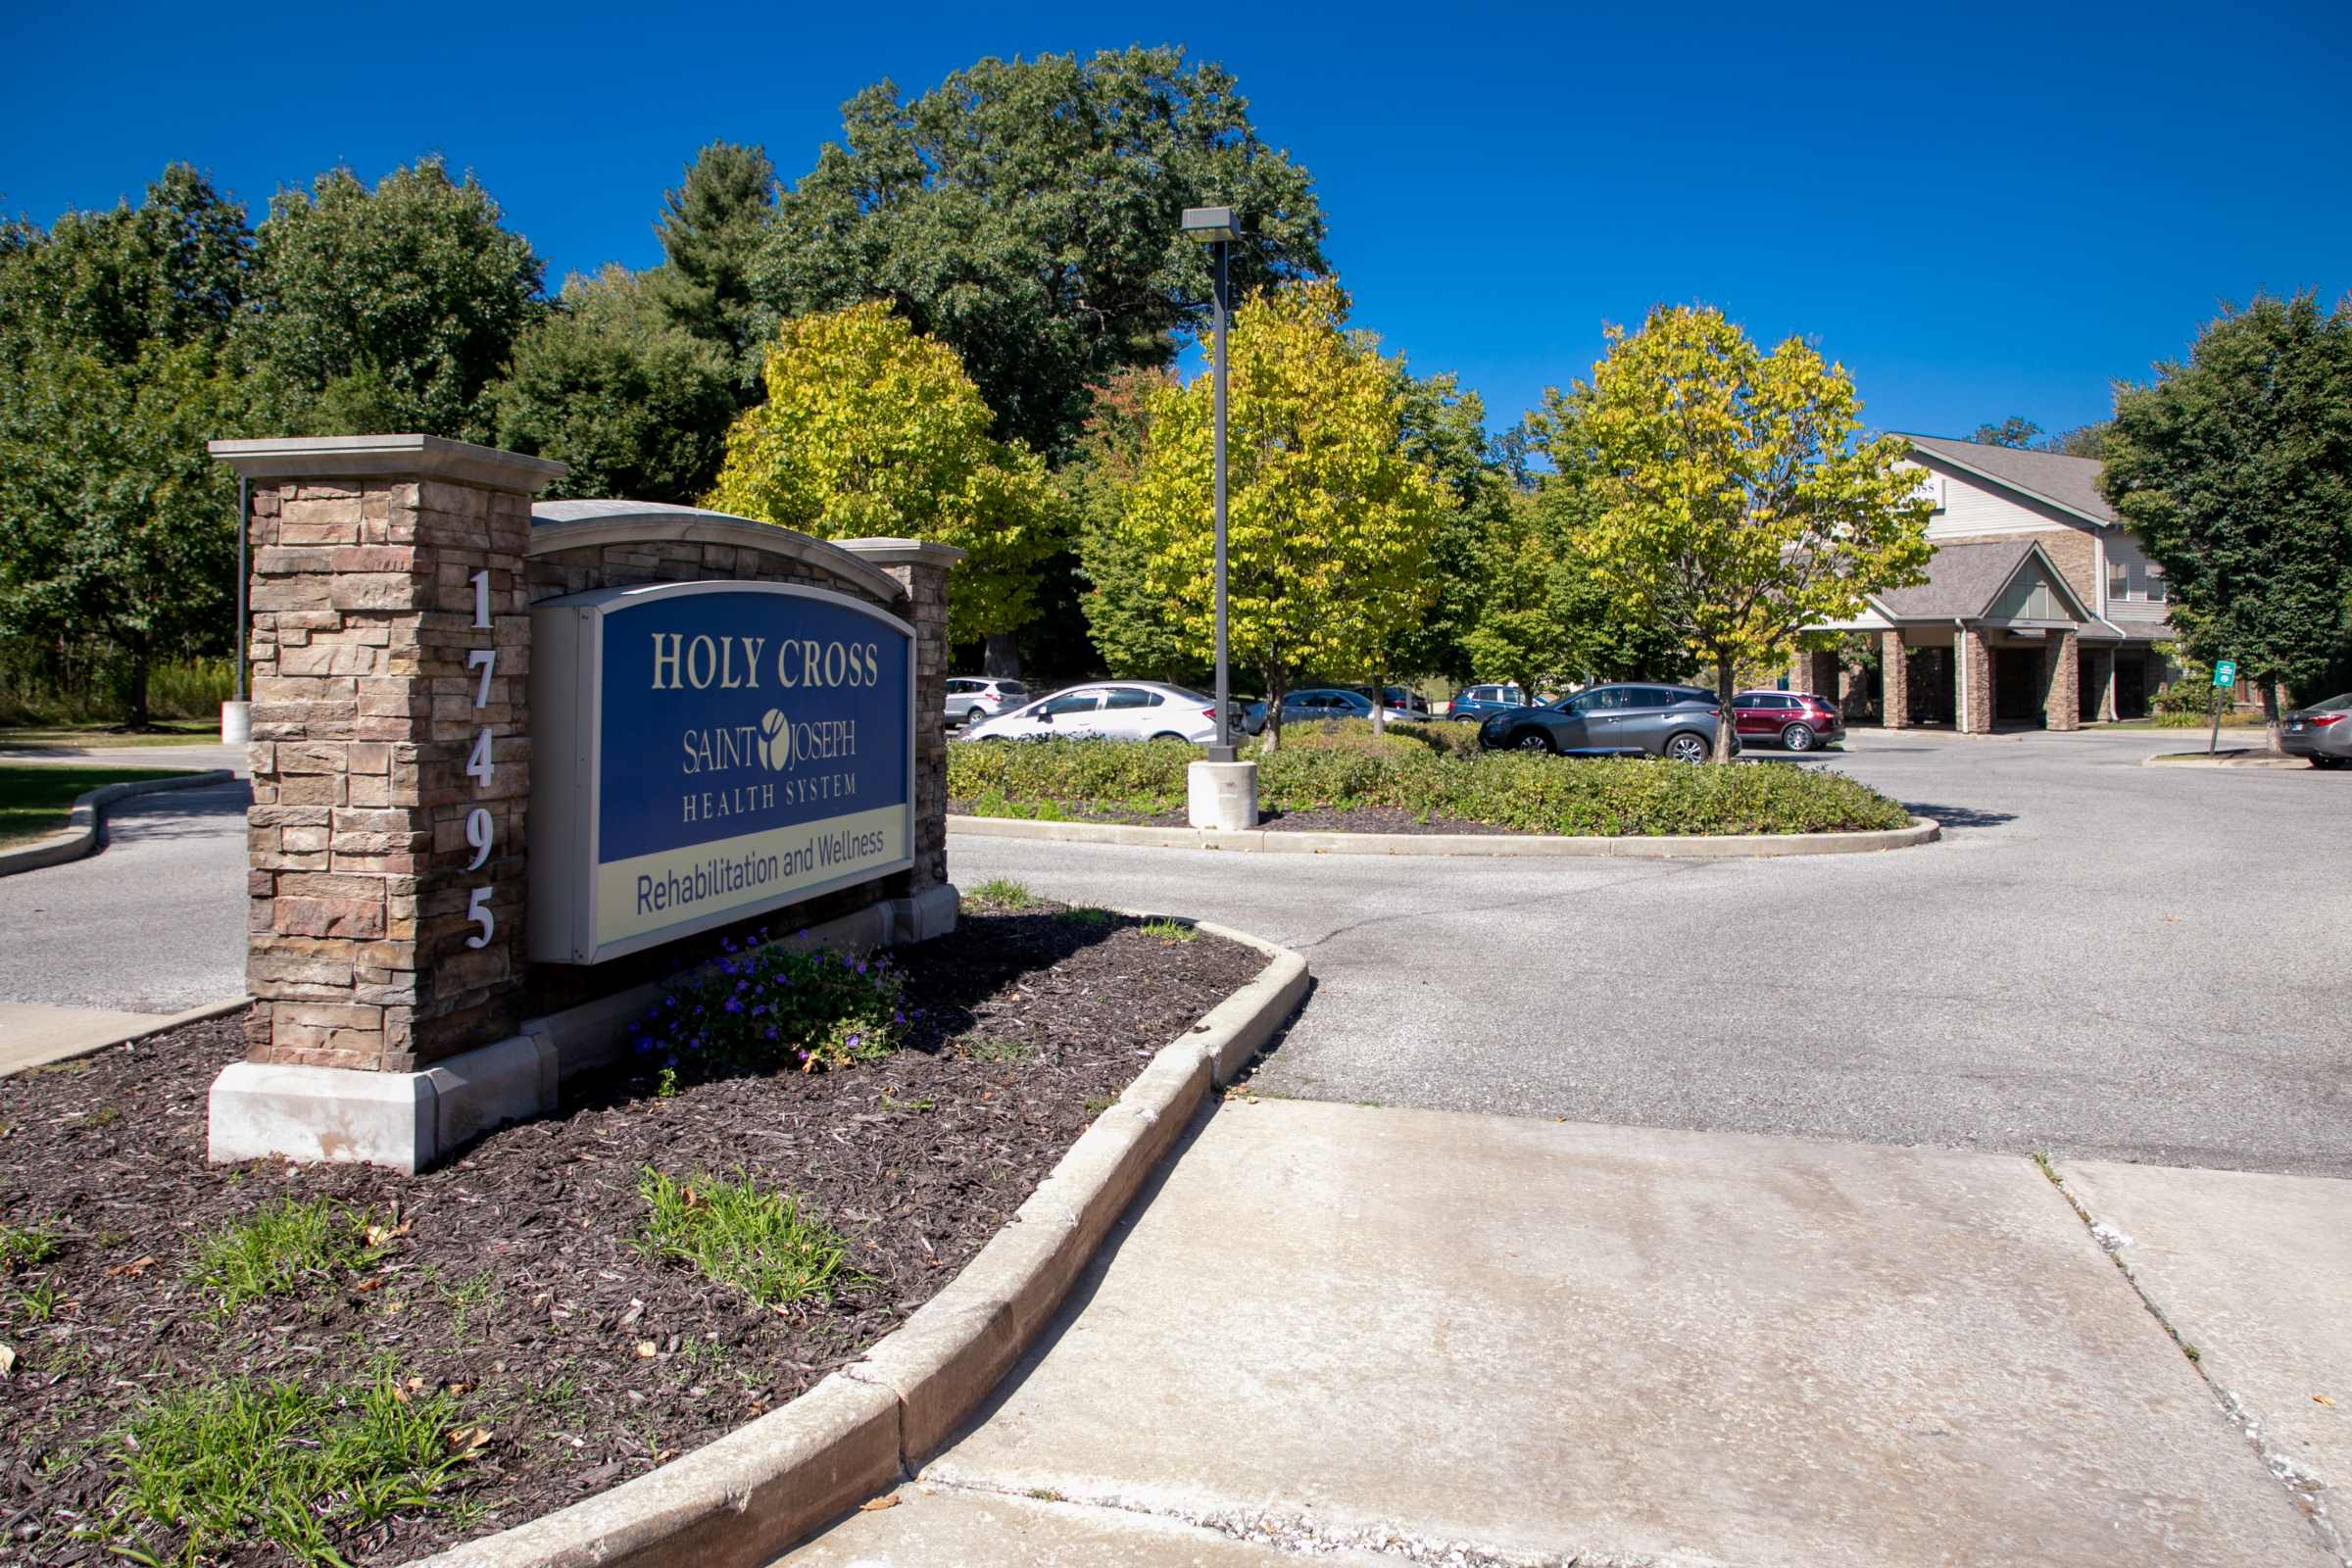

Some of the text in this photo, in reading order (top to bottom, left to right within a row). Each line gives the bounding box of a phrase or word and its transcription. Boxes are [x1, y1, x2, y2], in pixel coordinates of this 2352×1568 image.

[651, 632, 879, 690] HOLY CROSS
[466, 569, 496, 950] 17495
[682, 719, 856, 775] SAINT JOSEPH
[682, 773, 857, 822] HEALTH SYSTEM
[636, 829, 884, 915] Rehabilitation and Wellness
